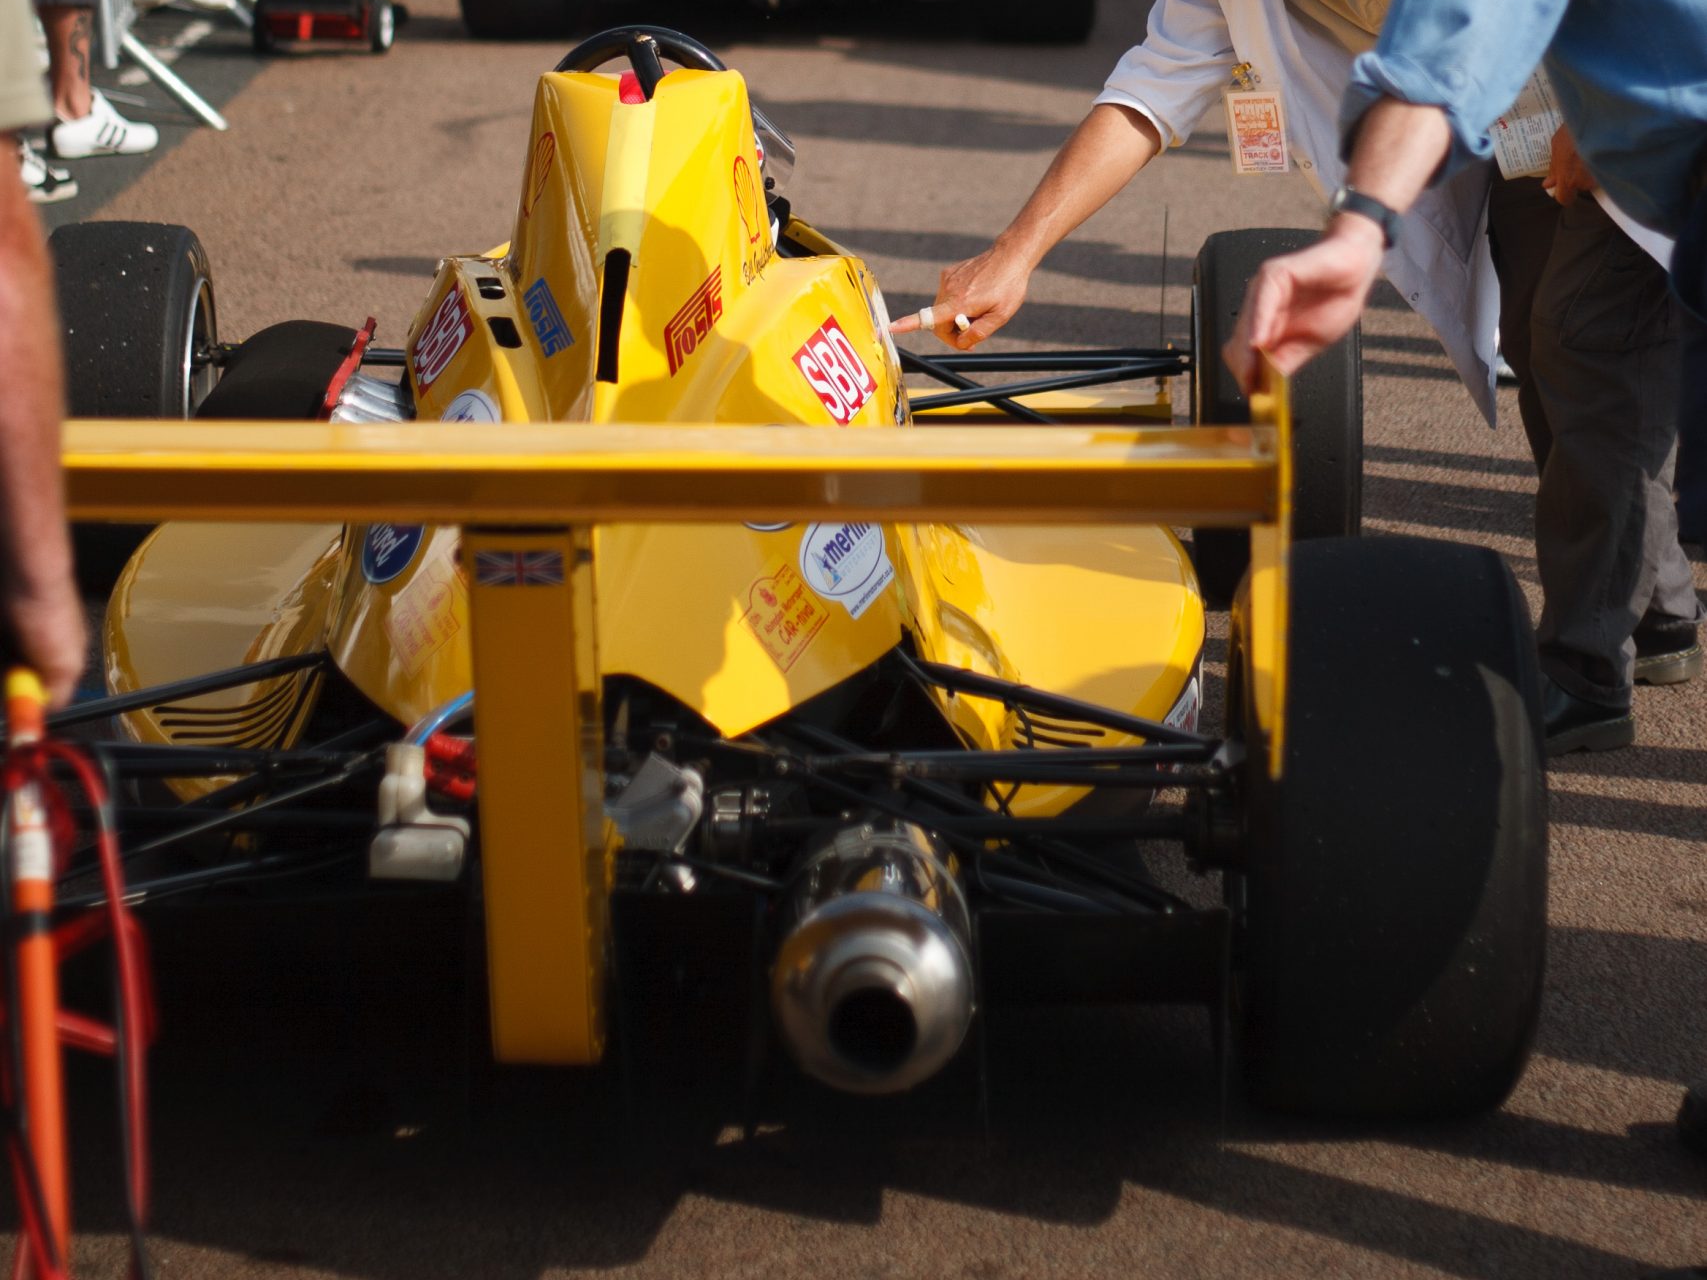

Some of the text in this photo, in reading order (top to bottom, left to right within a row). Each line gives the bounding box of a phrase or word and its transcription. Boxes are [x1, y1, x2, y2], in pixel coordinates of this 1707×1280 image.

[1243, 151, 1269, 160] TRACK
[413, 288, 467, 388] SBD
[799, 326, 874, 422] SBD
